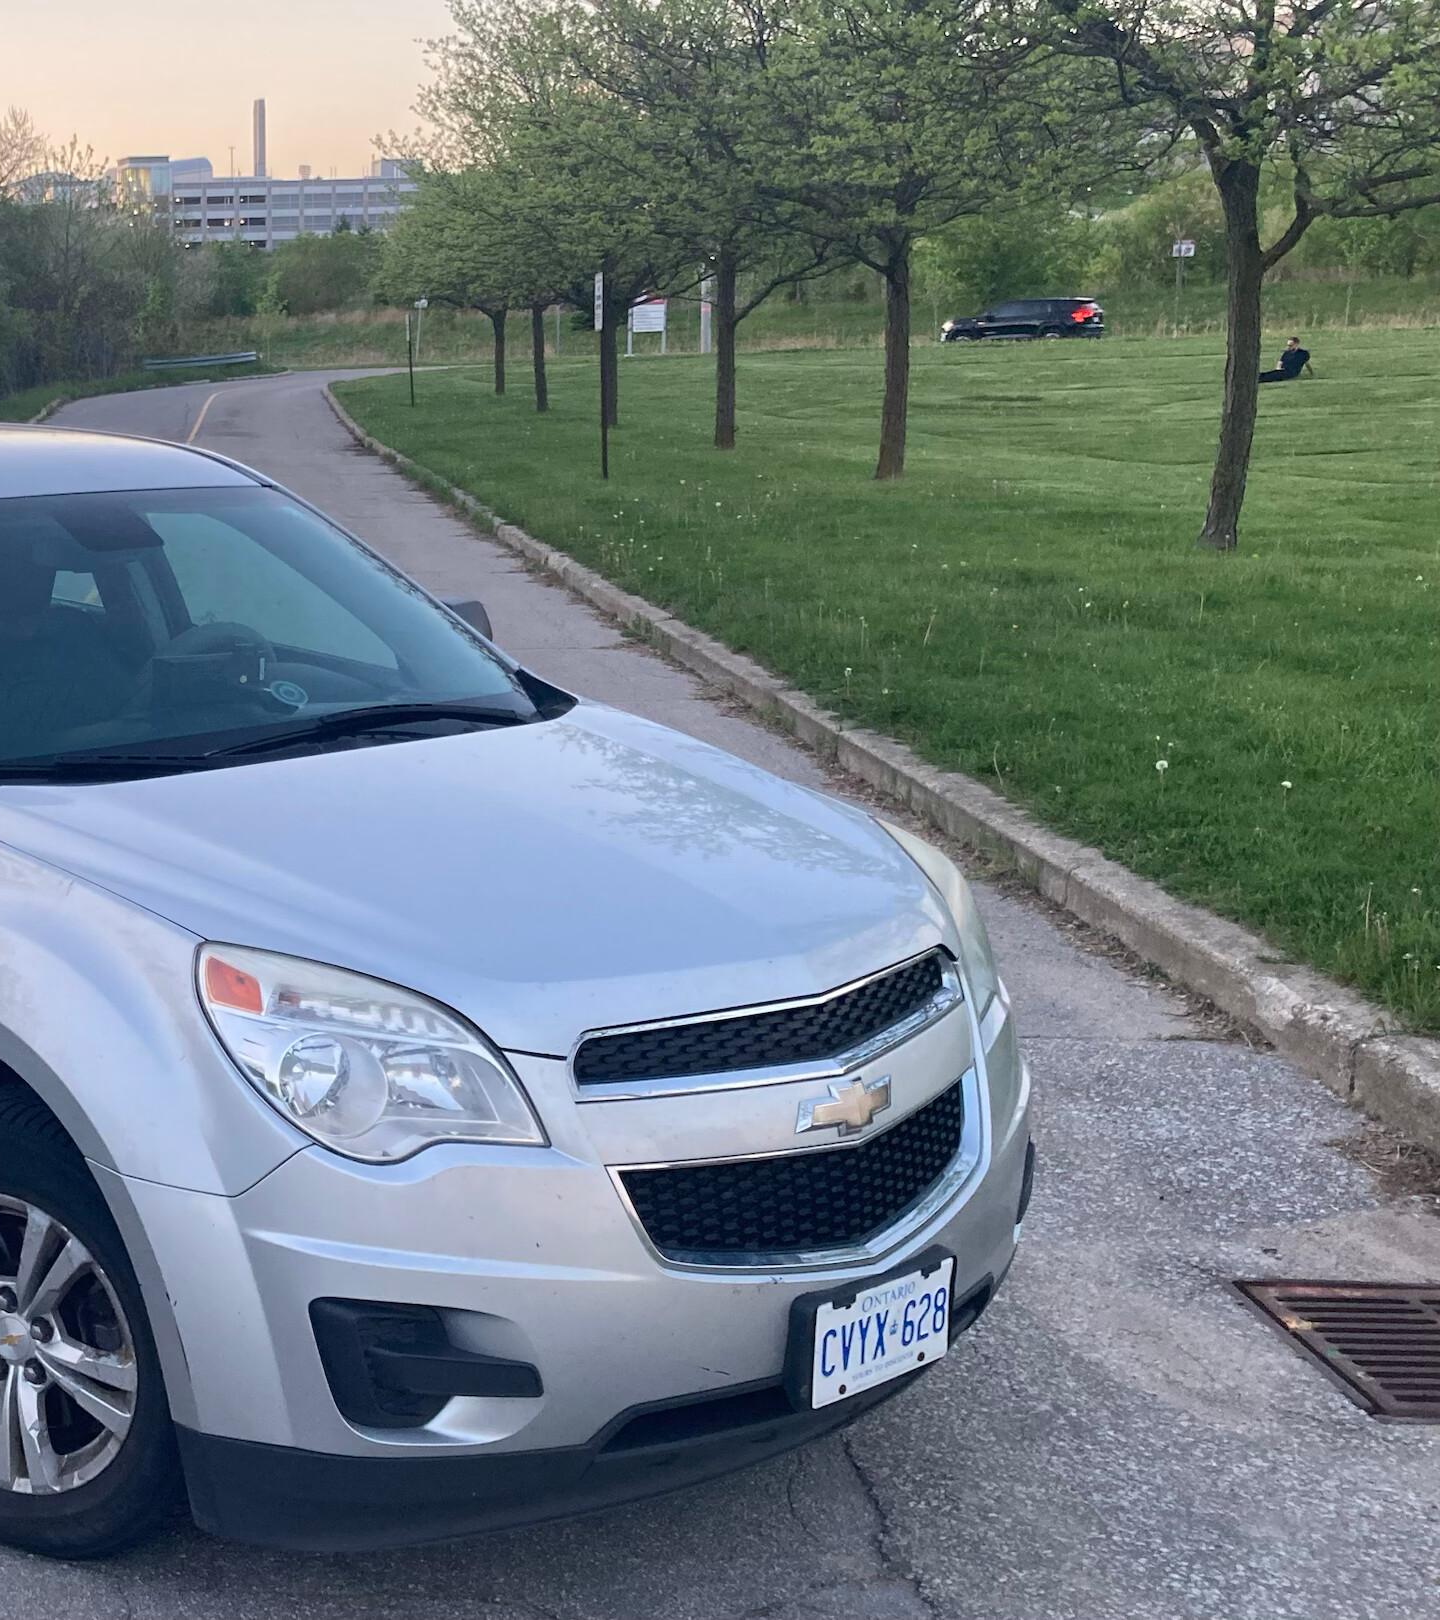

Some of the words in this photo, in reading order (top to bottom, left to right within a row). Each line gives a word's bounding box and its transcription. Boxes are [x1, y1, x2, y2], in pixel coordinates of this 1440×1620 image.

[862, 1281, 916, 1312] ONTARIO
[822, 1310, 889, 1377] CVYX
[901, 1287, 947, 1346] 628
